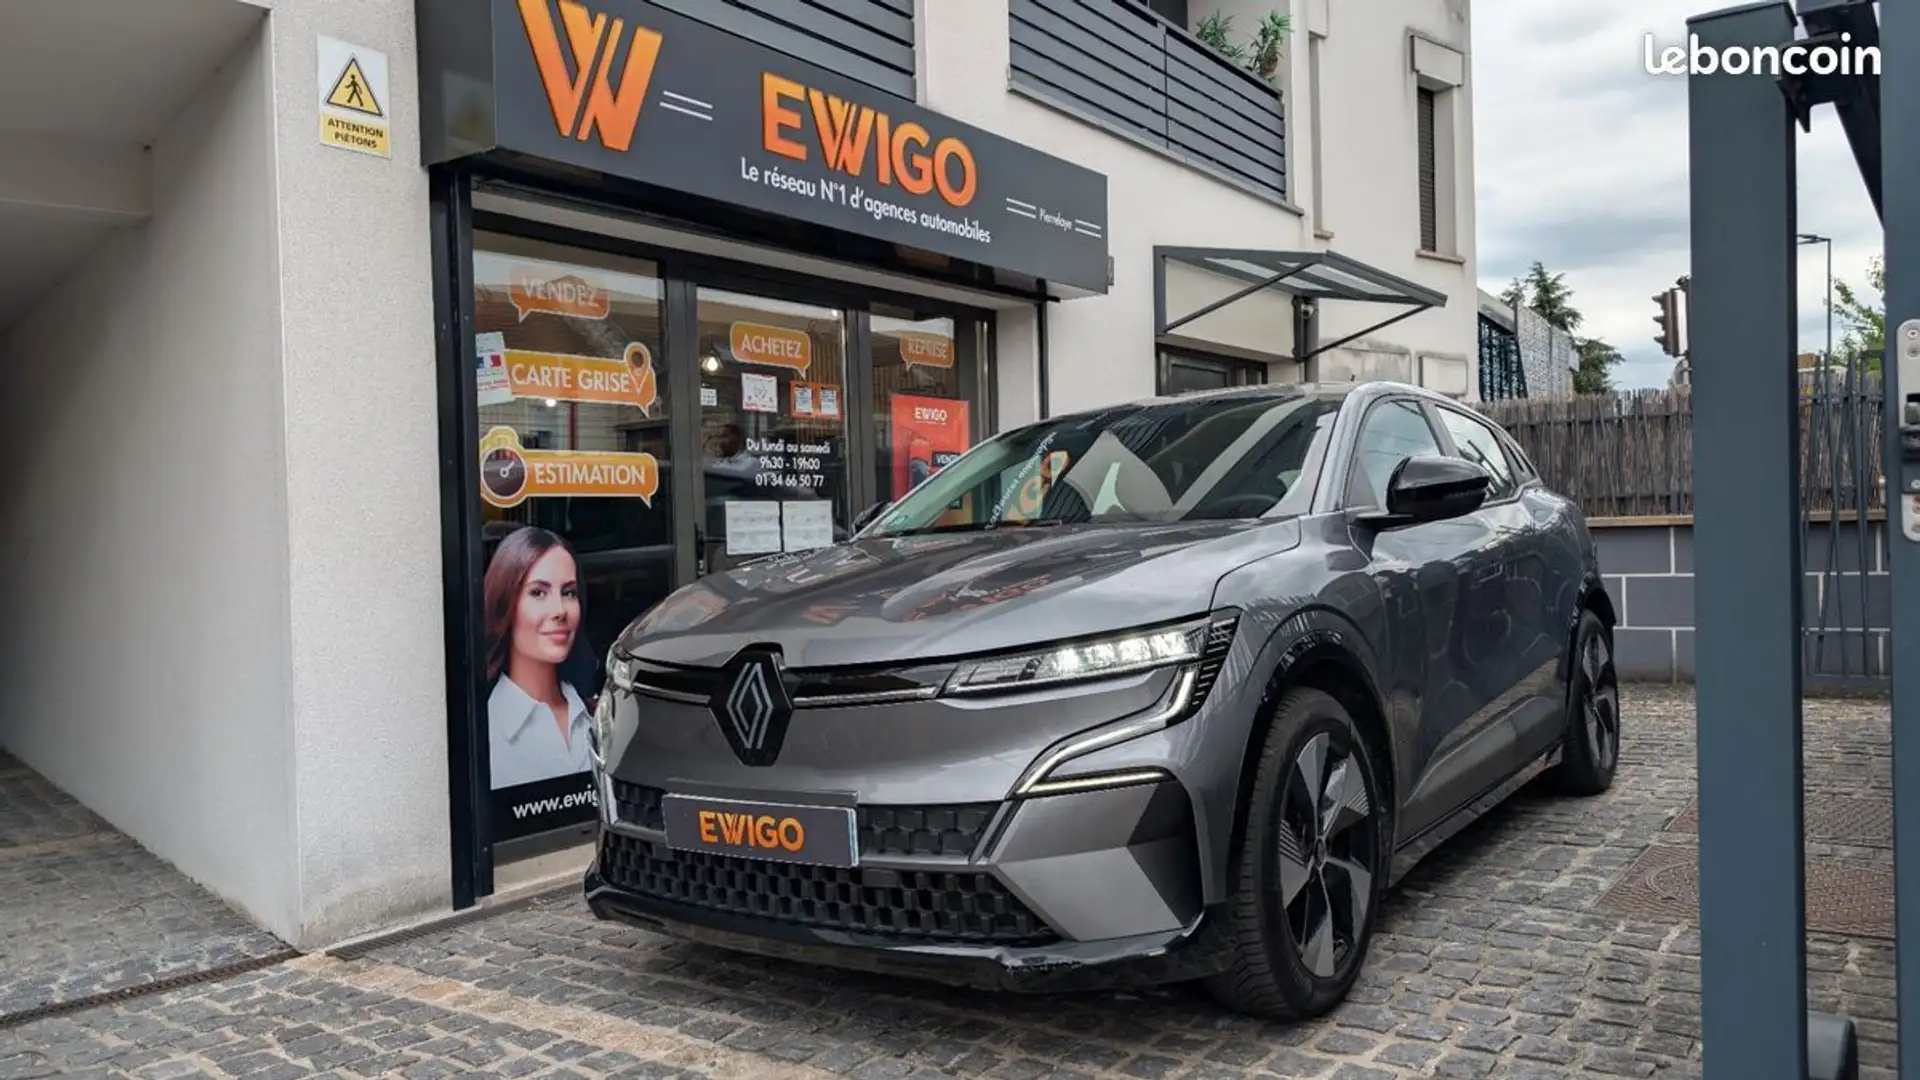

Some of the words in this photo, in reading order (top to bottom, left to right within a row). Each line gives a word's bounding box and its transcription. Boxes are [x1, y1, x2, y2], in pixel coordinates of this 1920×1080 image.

[327, 117, 384, 138] ATTENTION
[762, 71, 978, 208] EWIGO
[740, 156, 760, 182] Le
[763, 166, 817, 197] réseau
[850, 185, 918, 226] d'agences
[920, 210, 991, 244] automobiles
[522, 275, 600, 308] VENDEZ
[741, 333, 803, 359] ACHETEZ
[907, 337, 948, 359] REPRISE
[511, 363, 573, 389] CARTE
[578, 368, 631, 393] GRISE
[914, 406, 948, 422] EWIGO
[746, 438, 760, 452] Du
[761, 437, 785, 453] lundi
[786, 443, 799, 453] au
[800, 440, 832, 455] samedi
[760, 455, 784, 470] 9h30
[792, 456, 821, 470] 19h00
[534, 463, 646, 487] ESTIMATION
[755, 472, 768, 487] 01
[770, 473, 784, 487] 34
[785, 474, 798, 487] 66
[799, 474, 811, 487] 50
[812, 474, 825, 487] 77
[698, 810, 805, 852] EWIGO
